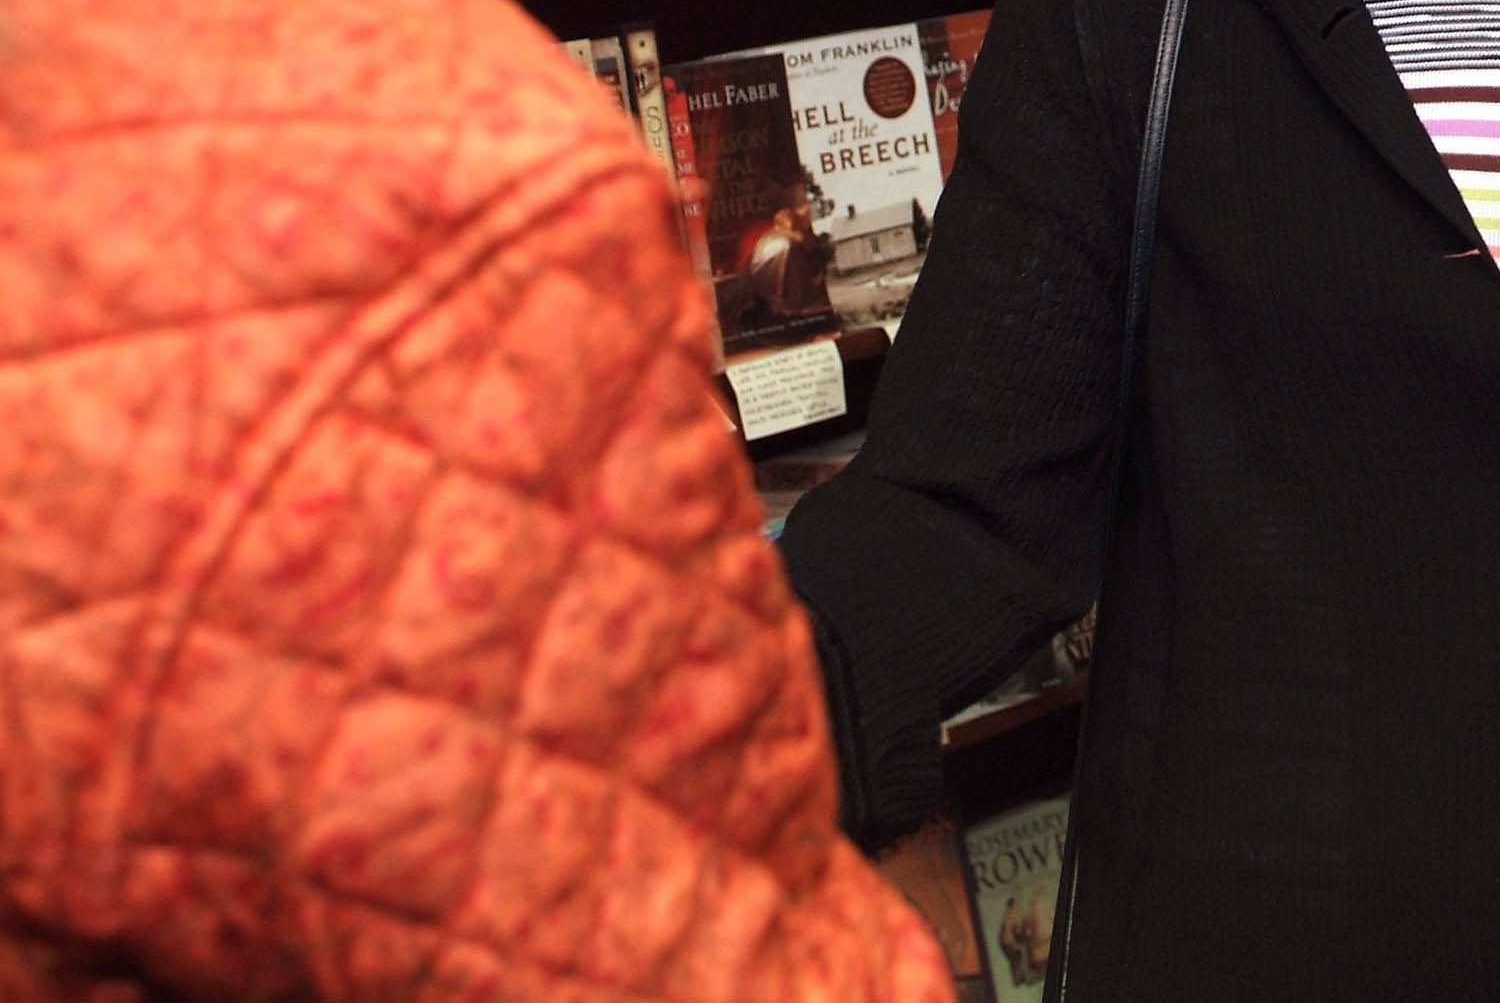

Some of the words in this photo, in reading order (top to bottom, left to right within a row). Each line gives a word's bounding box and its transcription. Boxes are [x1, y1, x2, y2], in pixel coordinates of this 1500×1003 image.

[820, 34, 913, 60] FRANKLIN
[828, 128, 844, 145] at
[852, 117, 878, 141] the
[819, 132, 930, 174] BREECH
